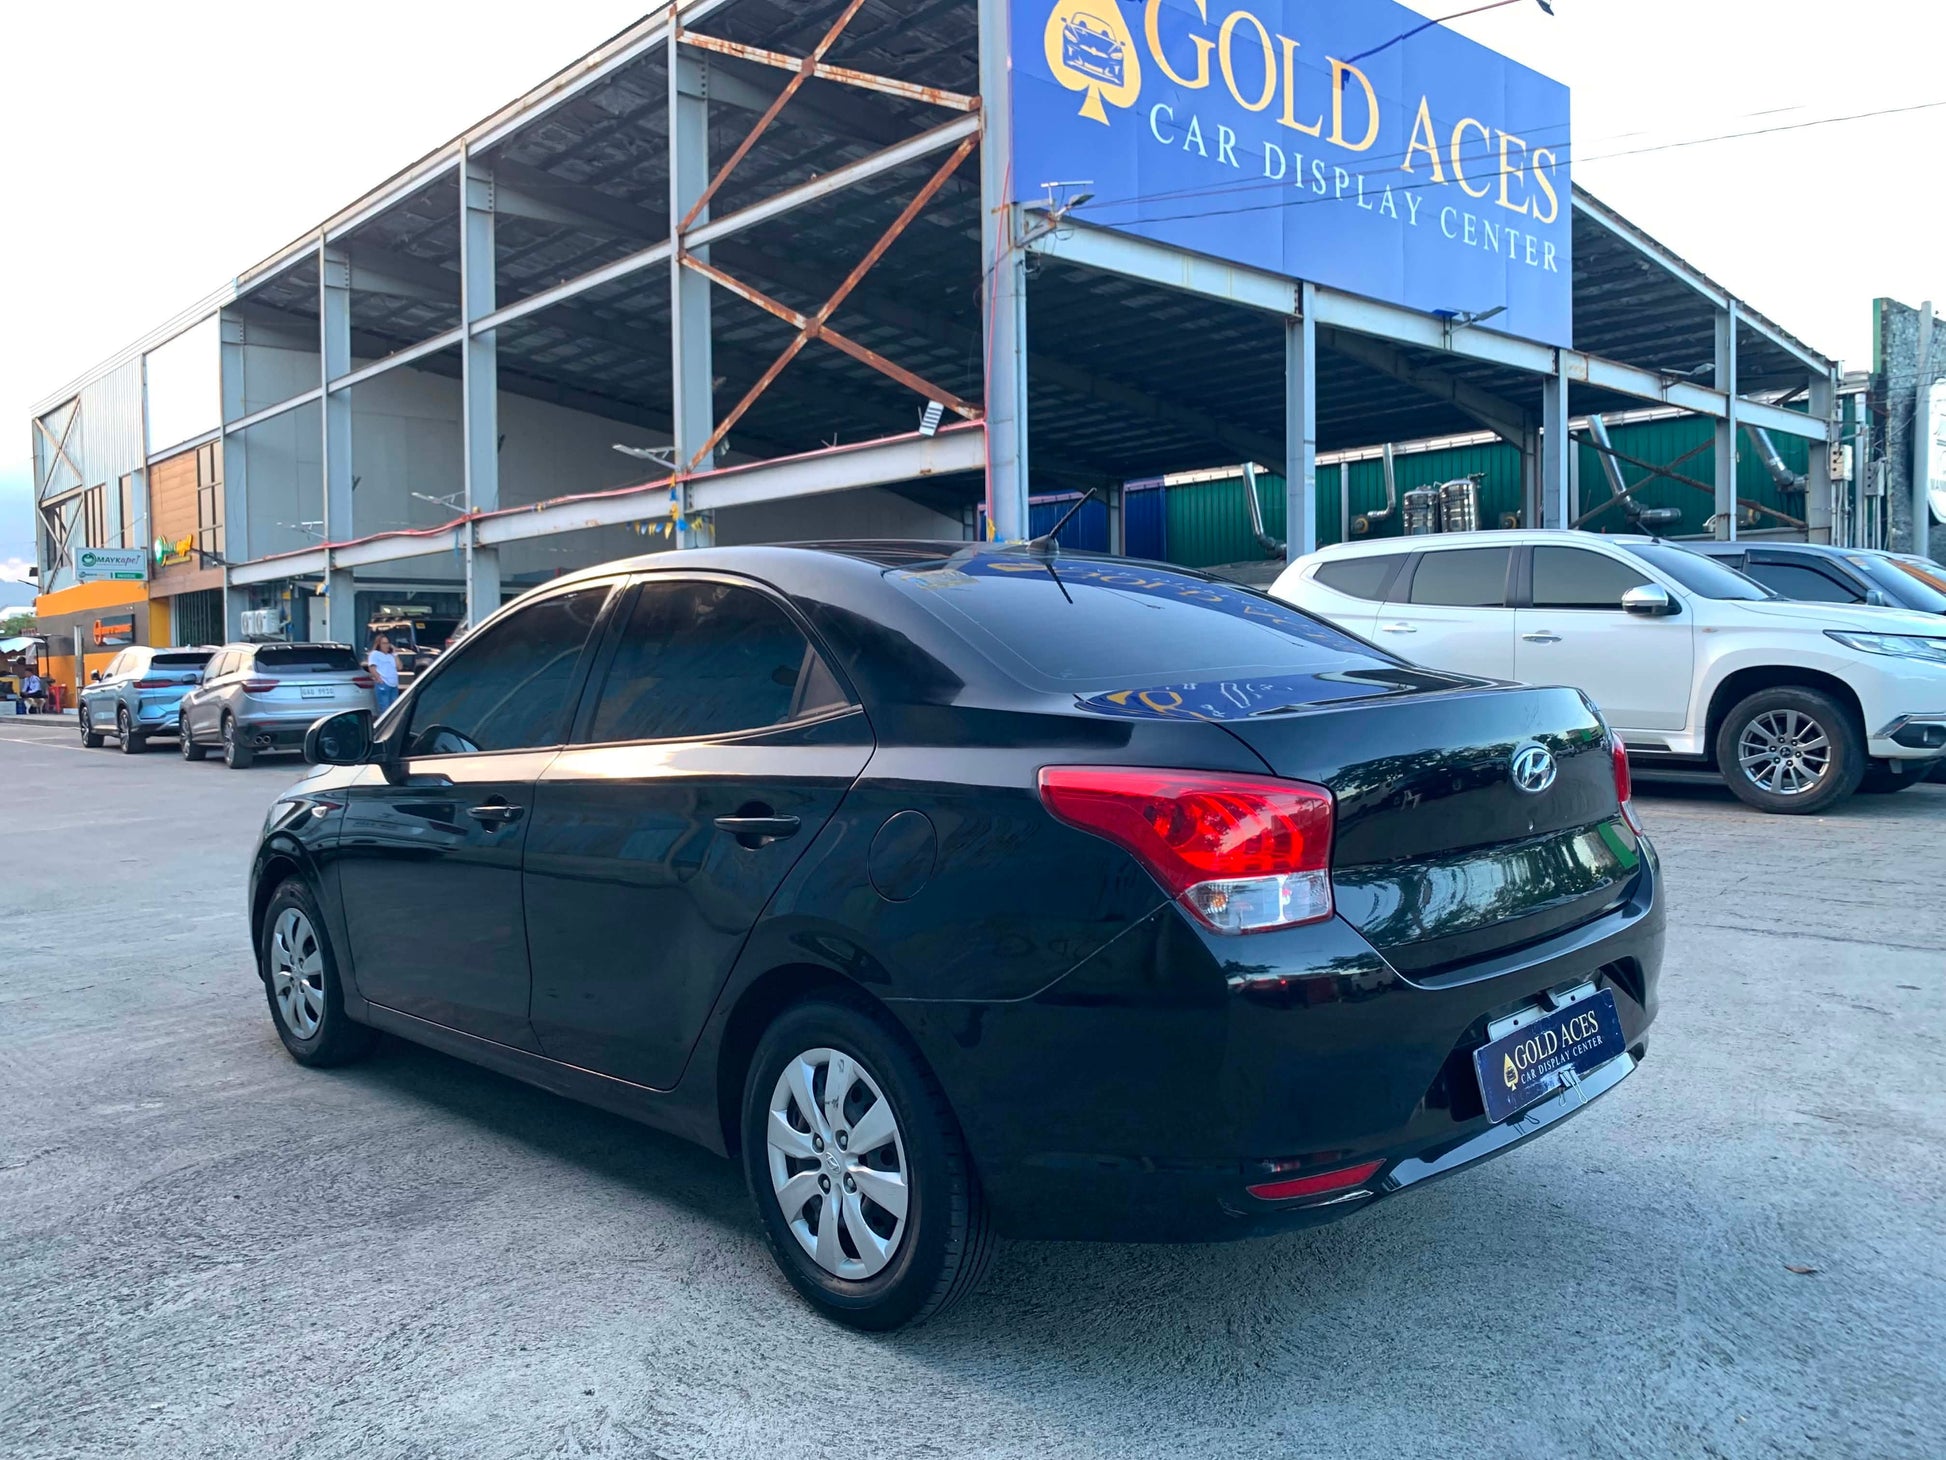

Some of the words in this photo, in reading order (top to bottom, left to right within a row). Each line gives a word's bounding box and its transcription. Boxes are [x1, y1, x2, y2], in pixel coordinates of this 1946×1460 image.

[1144, 0, 1380, 152] GOLD
[1400, 94, 1559, 224] ACES
[1149, 102, 1240, 169] CAR
[1262, 140, 1423, 227] DISPLAY
[1439, 205, 1559, 273] CENTER
[1514, 1030, 1557, 1068] GOLD
[1562, 1010, 1598, 1048] ACES
[1520, 1069, 1537, 1085] CAR
[1538, 1051, 1570, 1074] DISPLAY
[1573, 1035, 1603, 1056] CENTER
